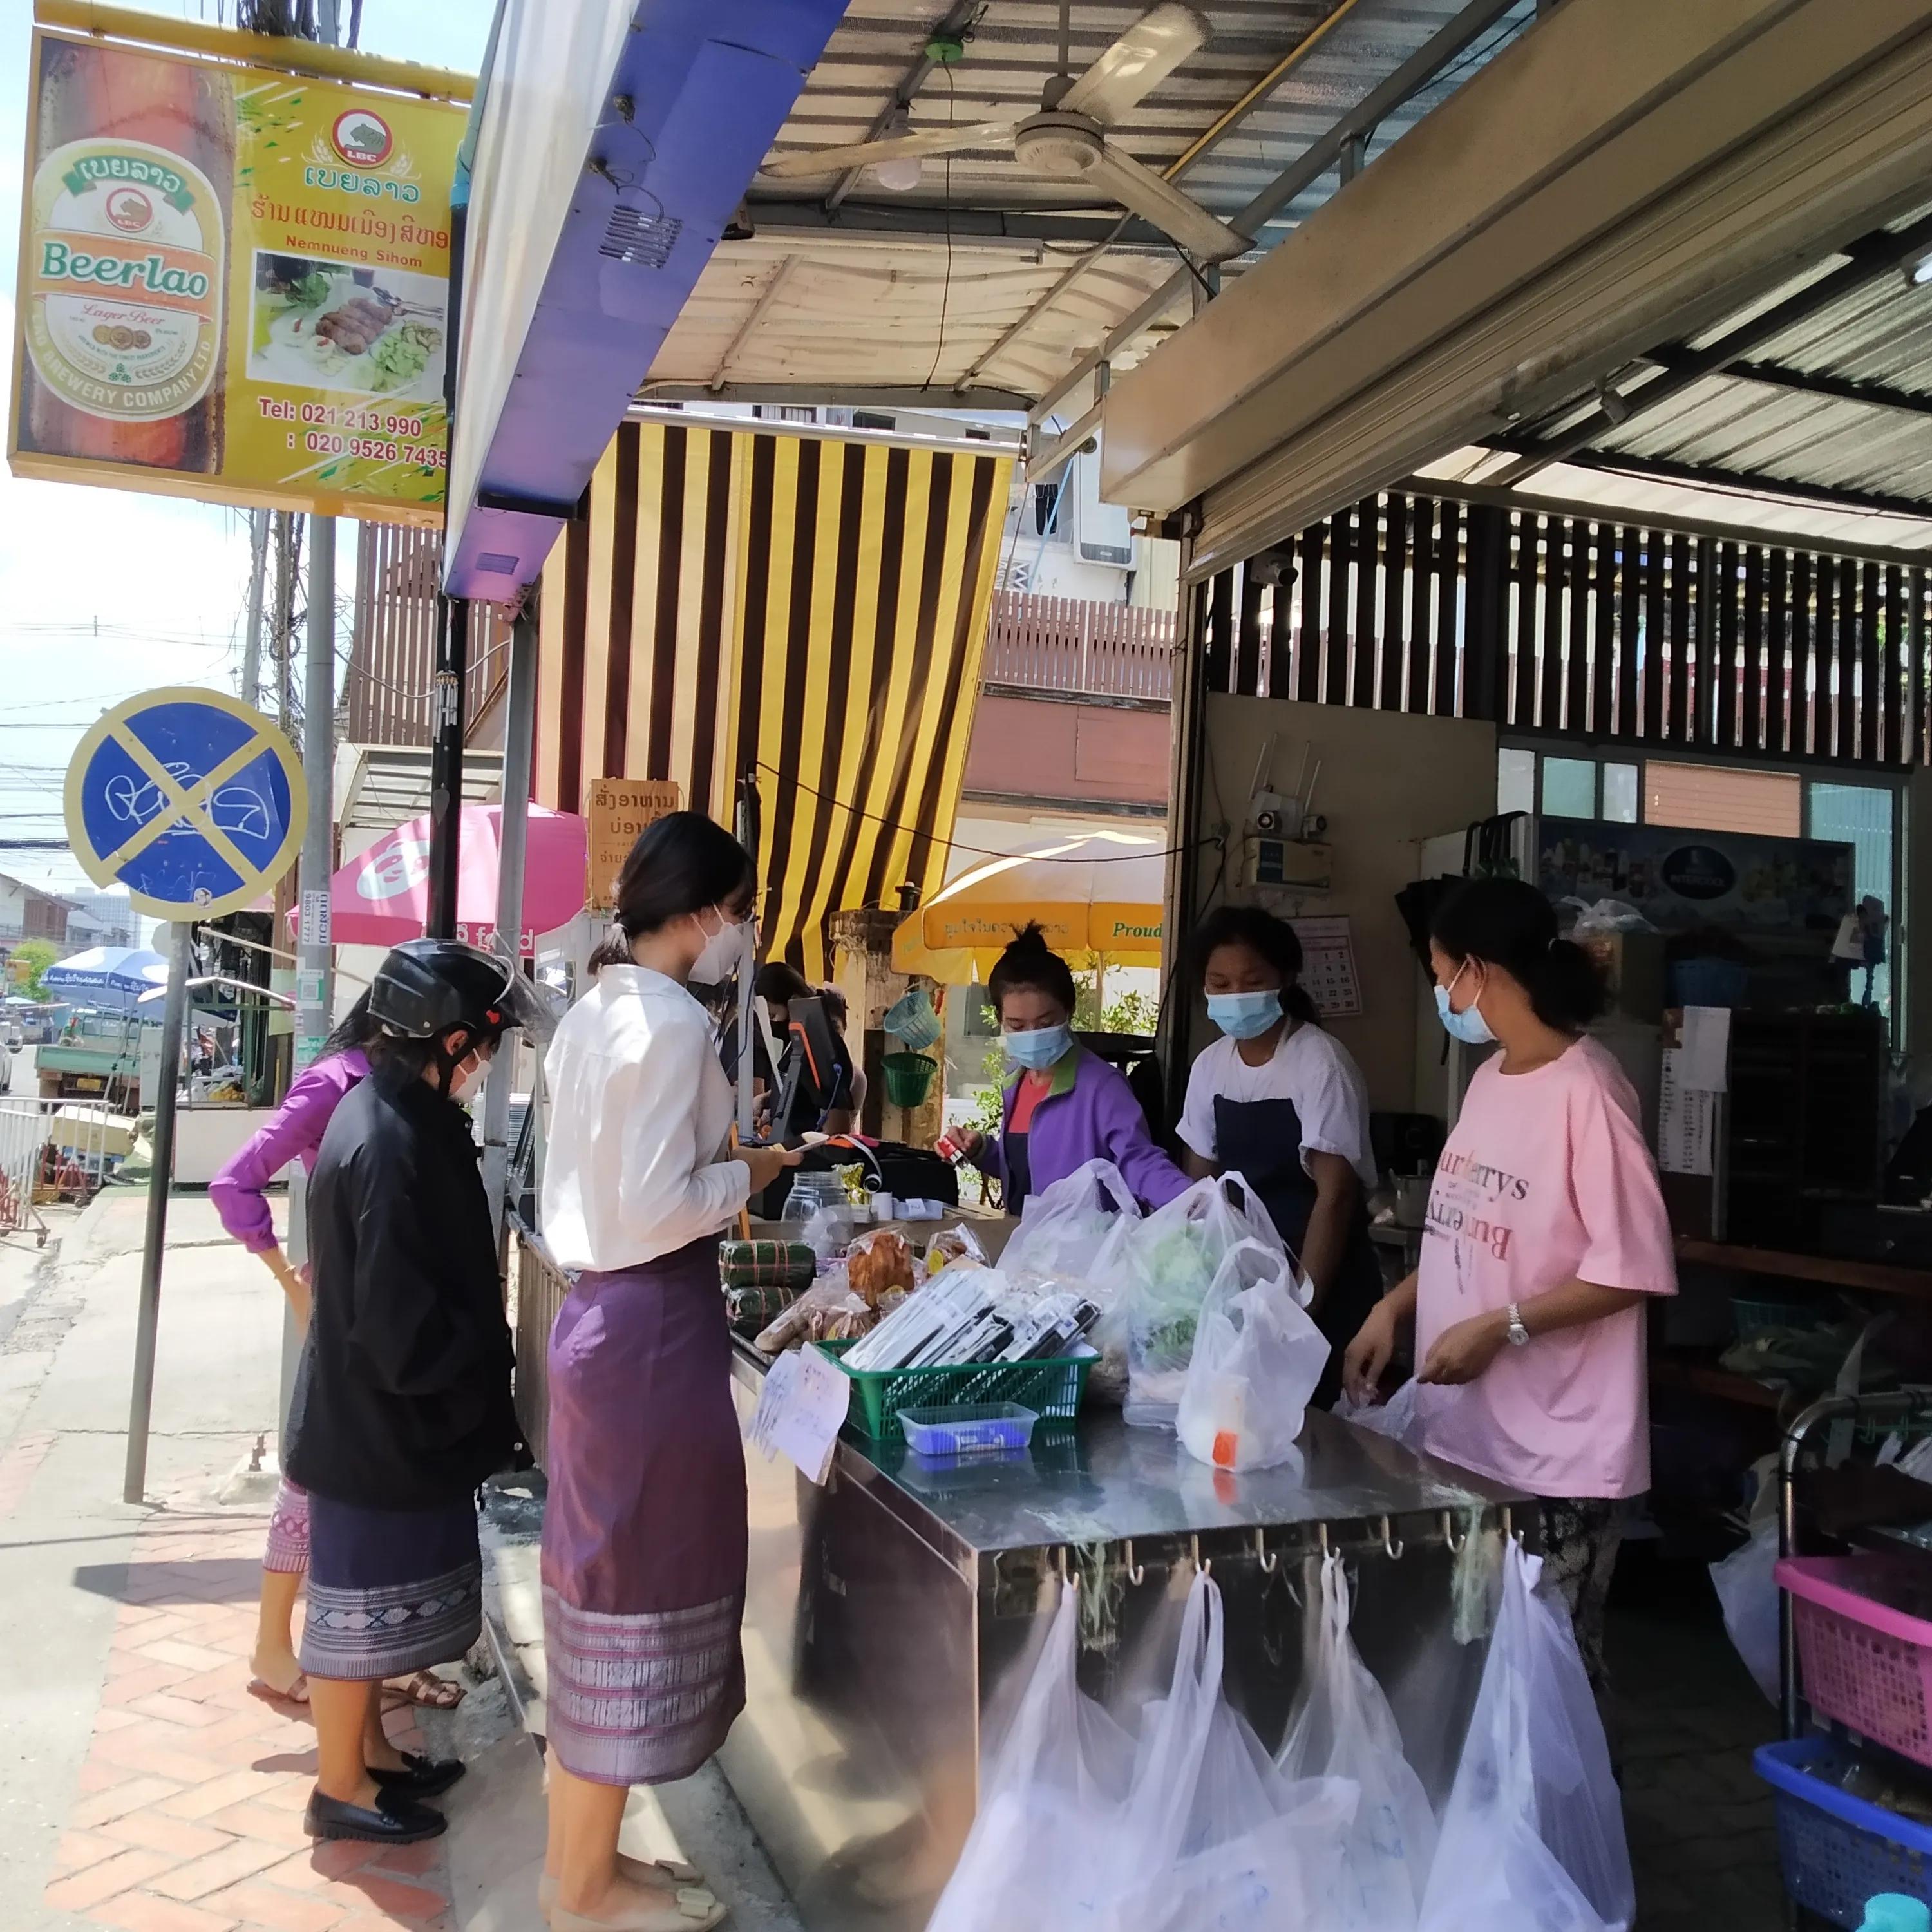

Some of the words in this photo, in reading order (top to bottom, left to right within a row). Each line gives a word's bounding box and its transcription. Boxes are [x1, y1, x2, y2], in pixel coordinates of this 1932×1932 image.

[347, 150, 377, 162] LBC
[80, 158, 181, 193] ເບຍລາວ
[305, 167, 419, 203] ເບຍລາວ
[287, 235, 368, 261] Nemnueng
[377, 250, 422, 267] Sihom
[41, 242, 208, 297] Beerlao
[81, 304, 127, 321] Lager
[128, 310, 165, 324] Beer
[43, 350, 118, 405] BREWERY
[123, 372, 198, 408] COMPANY
[258, 397, 294, 420] Tel:
[301, 404, 336, 424] 021
[344, 410, 380, 431] 213
[386, 417, 422, 437] 990
[307, 432, 343, 454] 020
[349, 438, 397, 461] 9526
[403, 445, 447, 468] 7435
[1113, 922, 1162, 938] Proud
